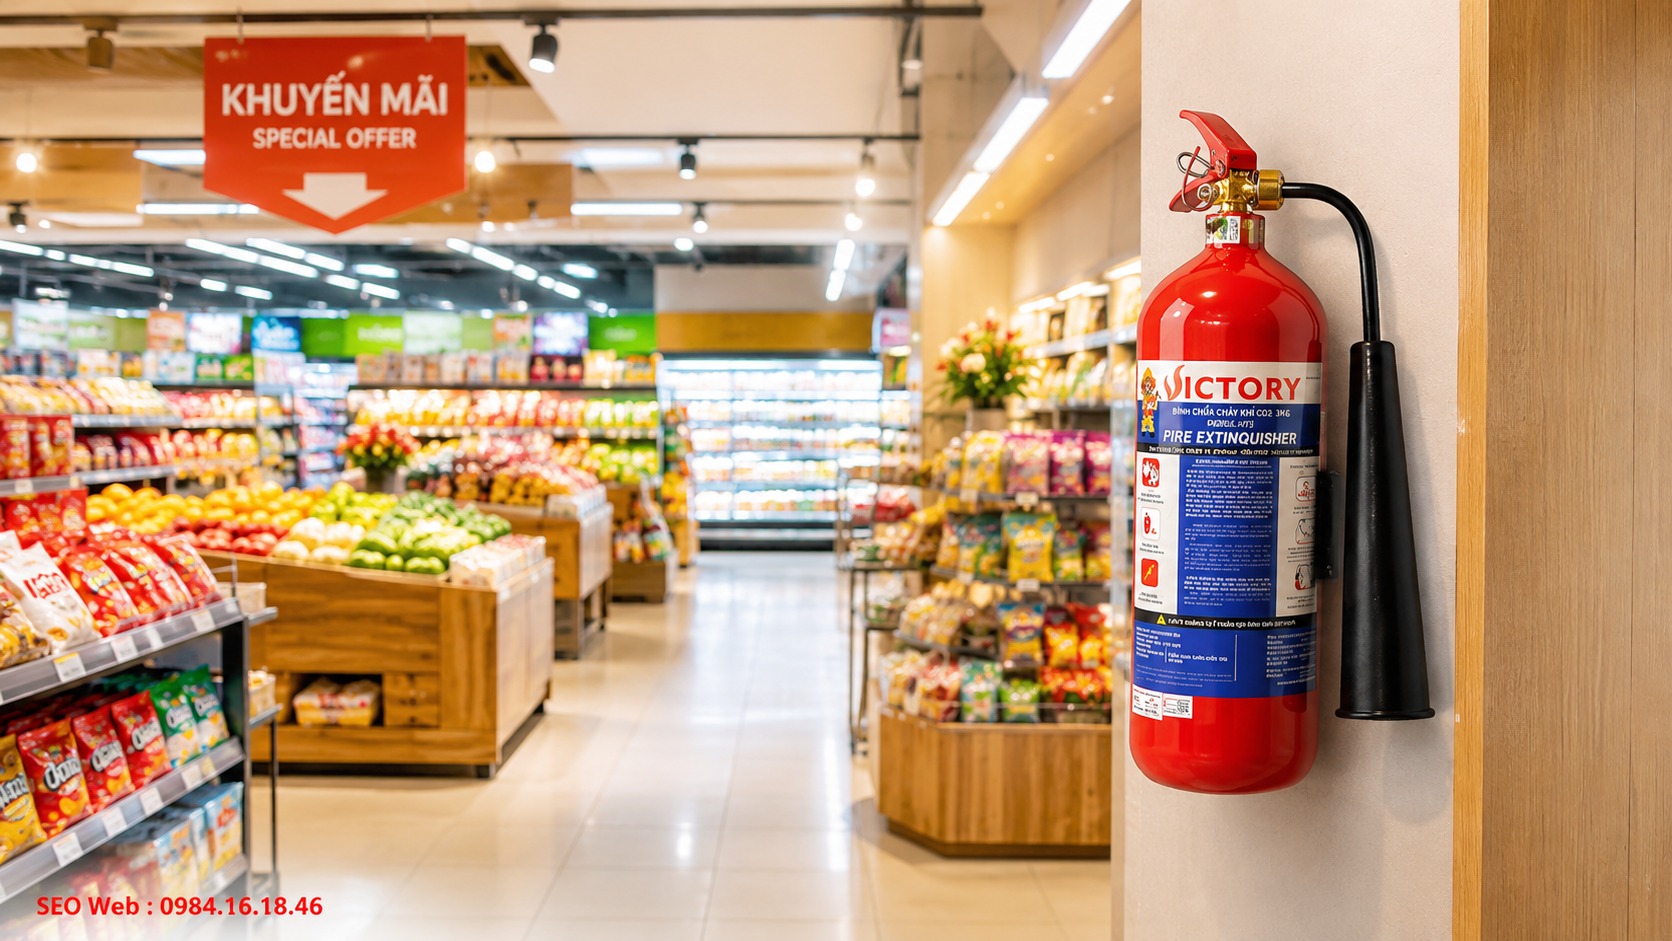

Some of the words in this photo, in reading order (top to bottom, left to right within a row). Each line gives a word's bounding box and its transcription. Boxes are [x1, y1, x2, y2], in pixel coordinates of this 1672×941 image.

[222, 70, 370, 116] KHUYẾN
[381, 74, 448, 116] MÃI
[253, 127, 341, 149] SPECIAL
[346, 127, 417, 149] OFFER
[1164, 364, 1301, 401] VICTORY
